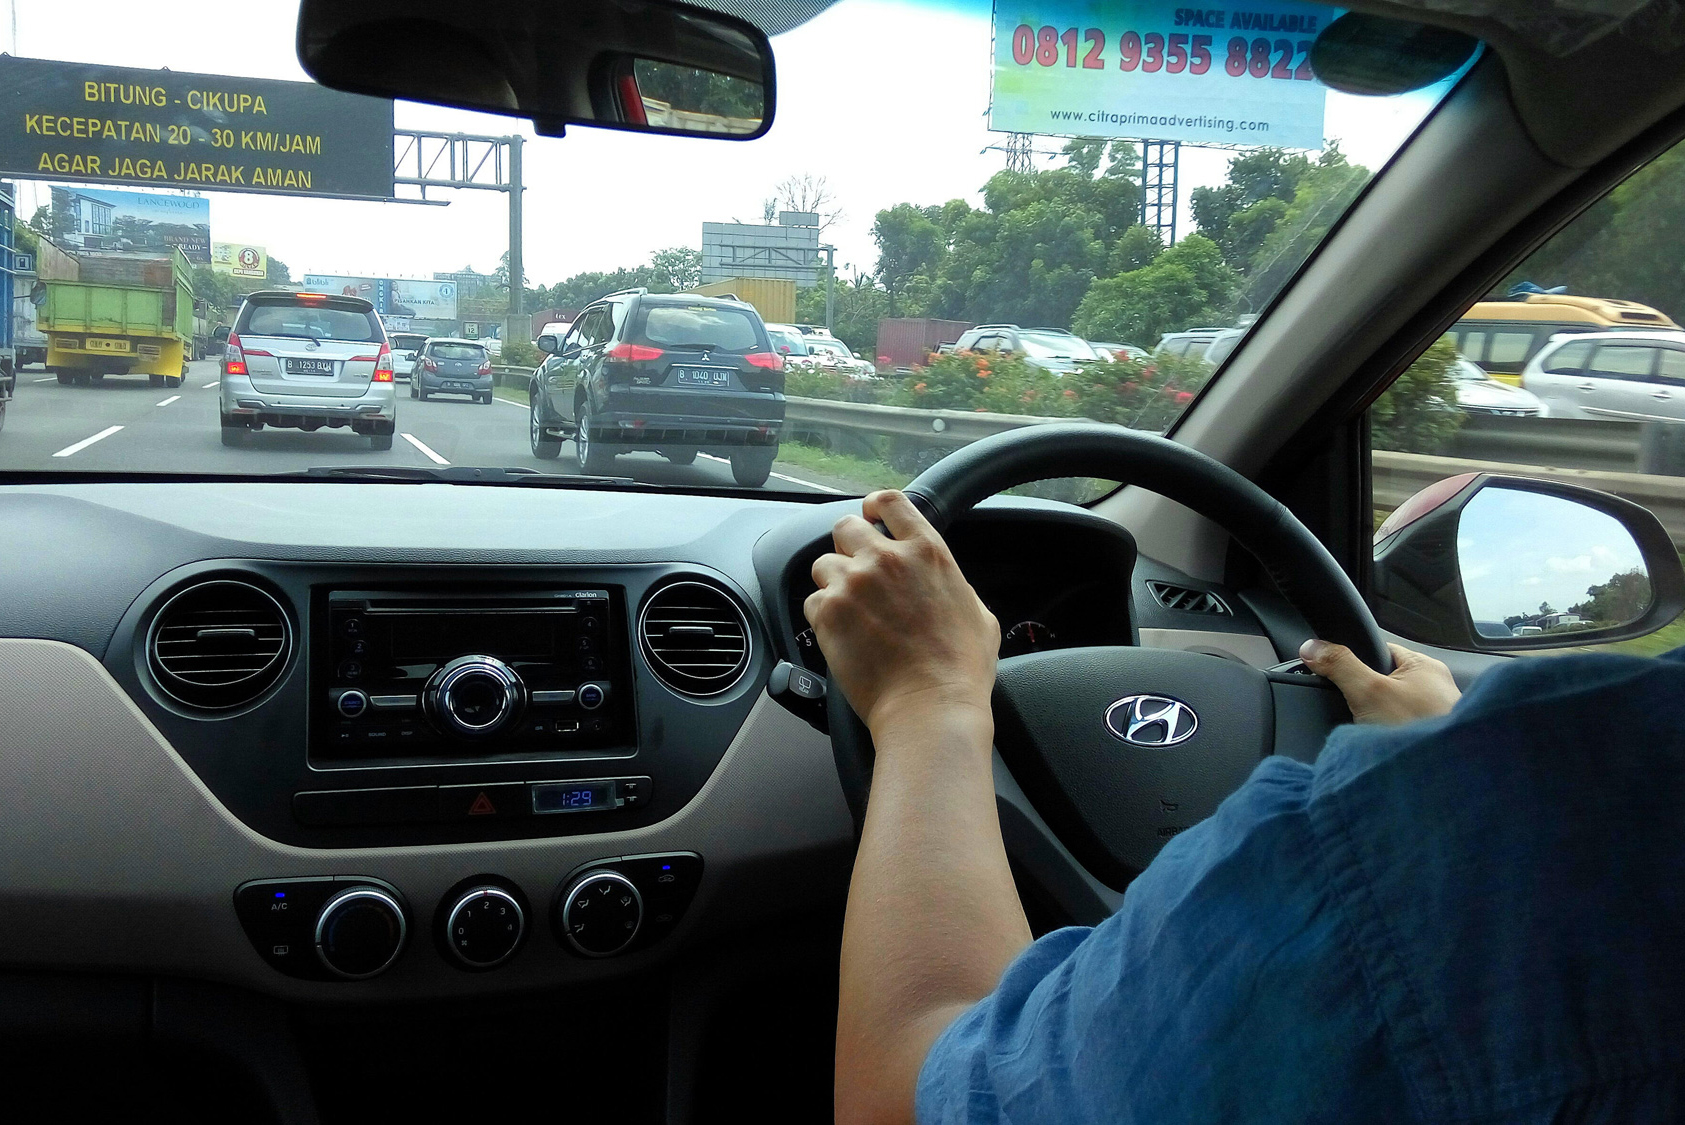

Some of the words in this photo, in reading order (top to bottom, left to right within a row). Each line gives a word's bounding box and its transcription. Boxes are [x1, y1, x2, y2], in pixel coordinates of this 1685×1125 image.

[1174, 8, 1225, 29] SPACE
[1229, 12, 1318, 34] AVAILABLE
[1012, 23, 1106, 70] 0812
[1119, 30, 1213, 75] 9355
[84, 81, 167, 107] BITUNG
[187, 90, 268, 115] CIKUPA
[1050, 109, 1270, 132] www.citraprimaadvertising.com
[25, 113, 161, 143] KECEPATAN
[167, 124, 191, 145] 20
[211, 128, 235, 149] 30
[241, 130, 321, 155] KM/JAM
[38, 152, 101, 175] AGAR
[108, 157, 168, 179] JAGA
[173, 161, 245, 185] JARAK
[252, 167, 312, 189] AMAN
[287, 359, 293, 369] B
[299, 361, 316, 370] 1253
[679, 369, 686, 379] B
[692, 370, 709, 381] 1040
[805, 638, 812, 647] 5
[1006, 632, 1012, 640] C
[562, 790, 592, 806] 1:29
[271, 902, 288, 911] A/C
[483, 901, 490, 909] 2
[500, 907, 506, 915] 3
